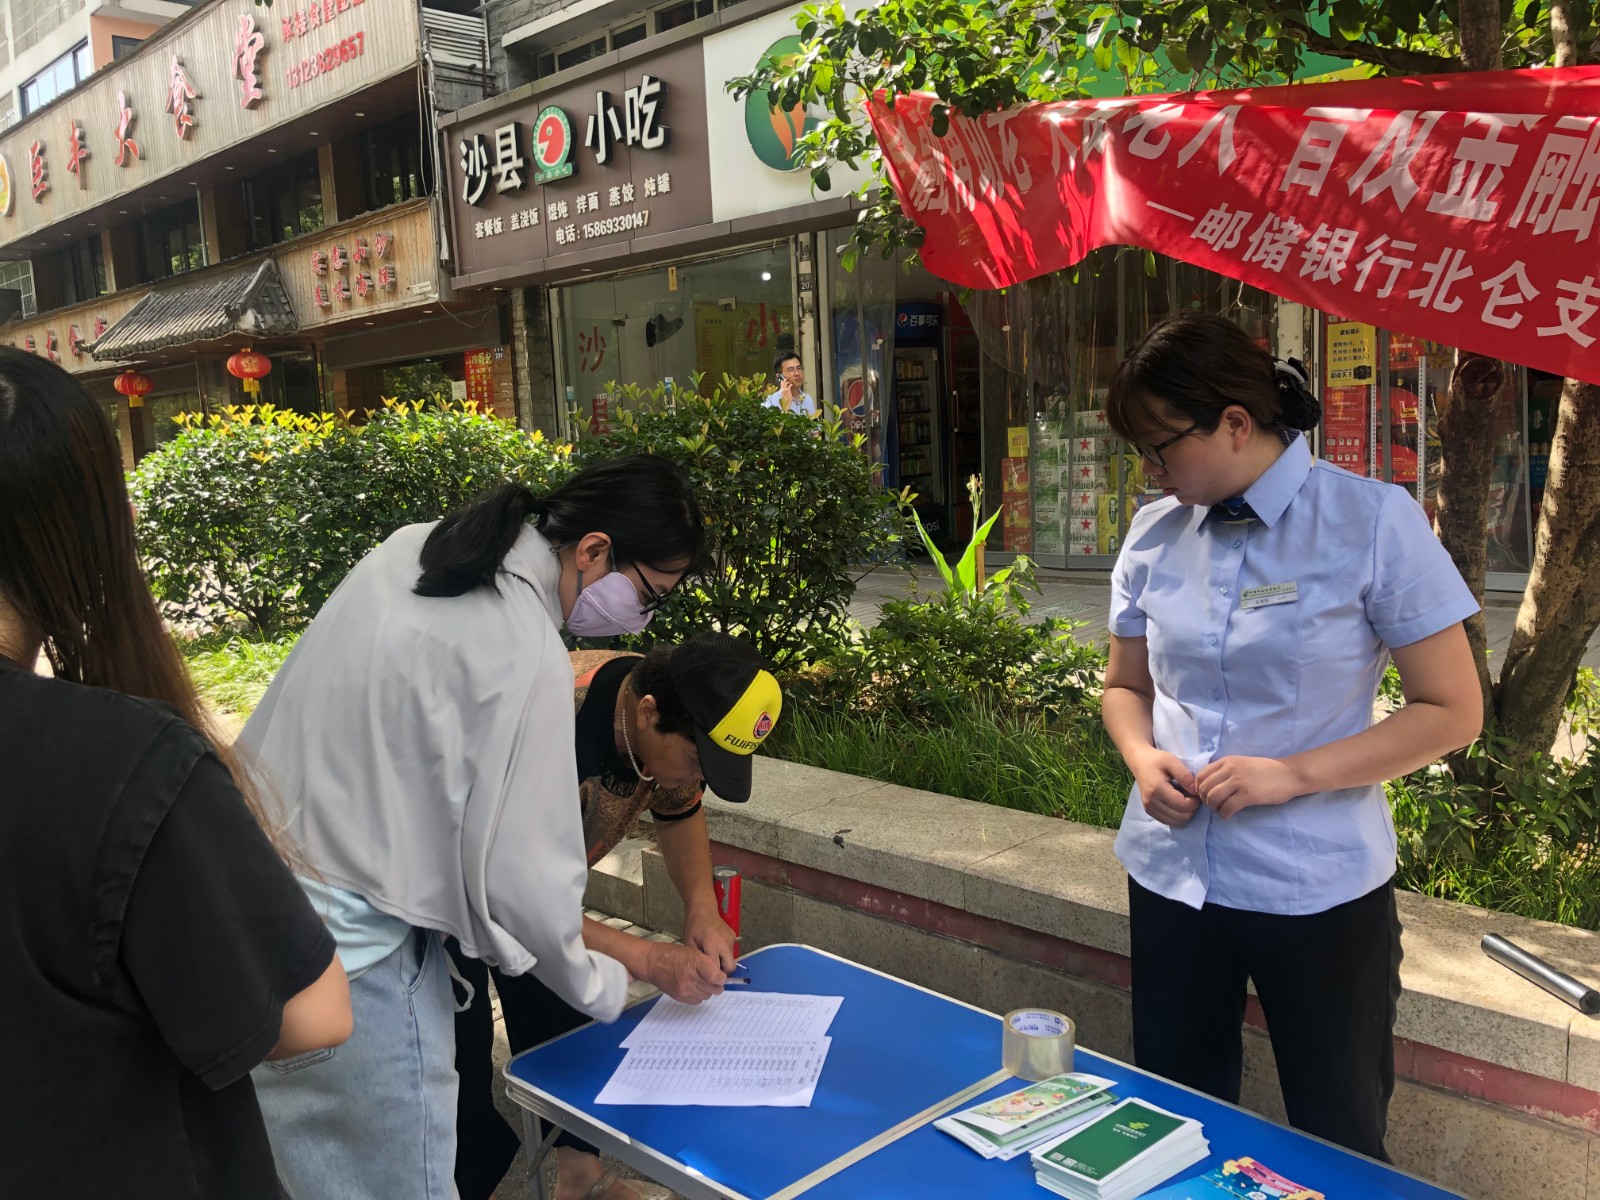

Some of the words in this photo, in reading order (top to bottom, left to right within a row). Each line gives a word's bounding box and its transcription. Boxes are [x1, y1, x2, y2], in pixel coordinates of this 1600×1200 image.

[281, 0, 366, 43] 承接食堂
[460, 121, 525, 206] 沙县
[585, 73, 666, 166] 小吃
[510, 206, 540, 231] 盖浇饭
[547, 200, 569, 222] 馄饨
[576, 191, 600, 214] 拌面
[608, 183, 635, 207] 蒸饺
[644, 172, 671, 198] 炖罐
[744, 302, 782, 349] 小
[910, 314, 939, 327] 百事可乐
[850, 413, 874, 431] pepi
